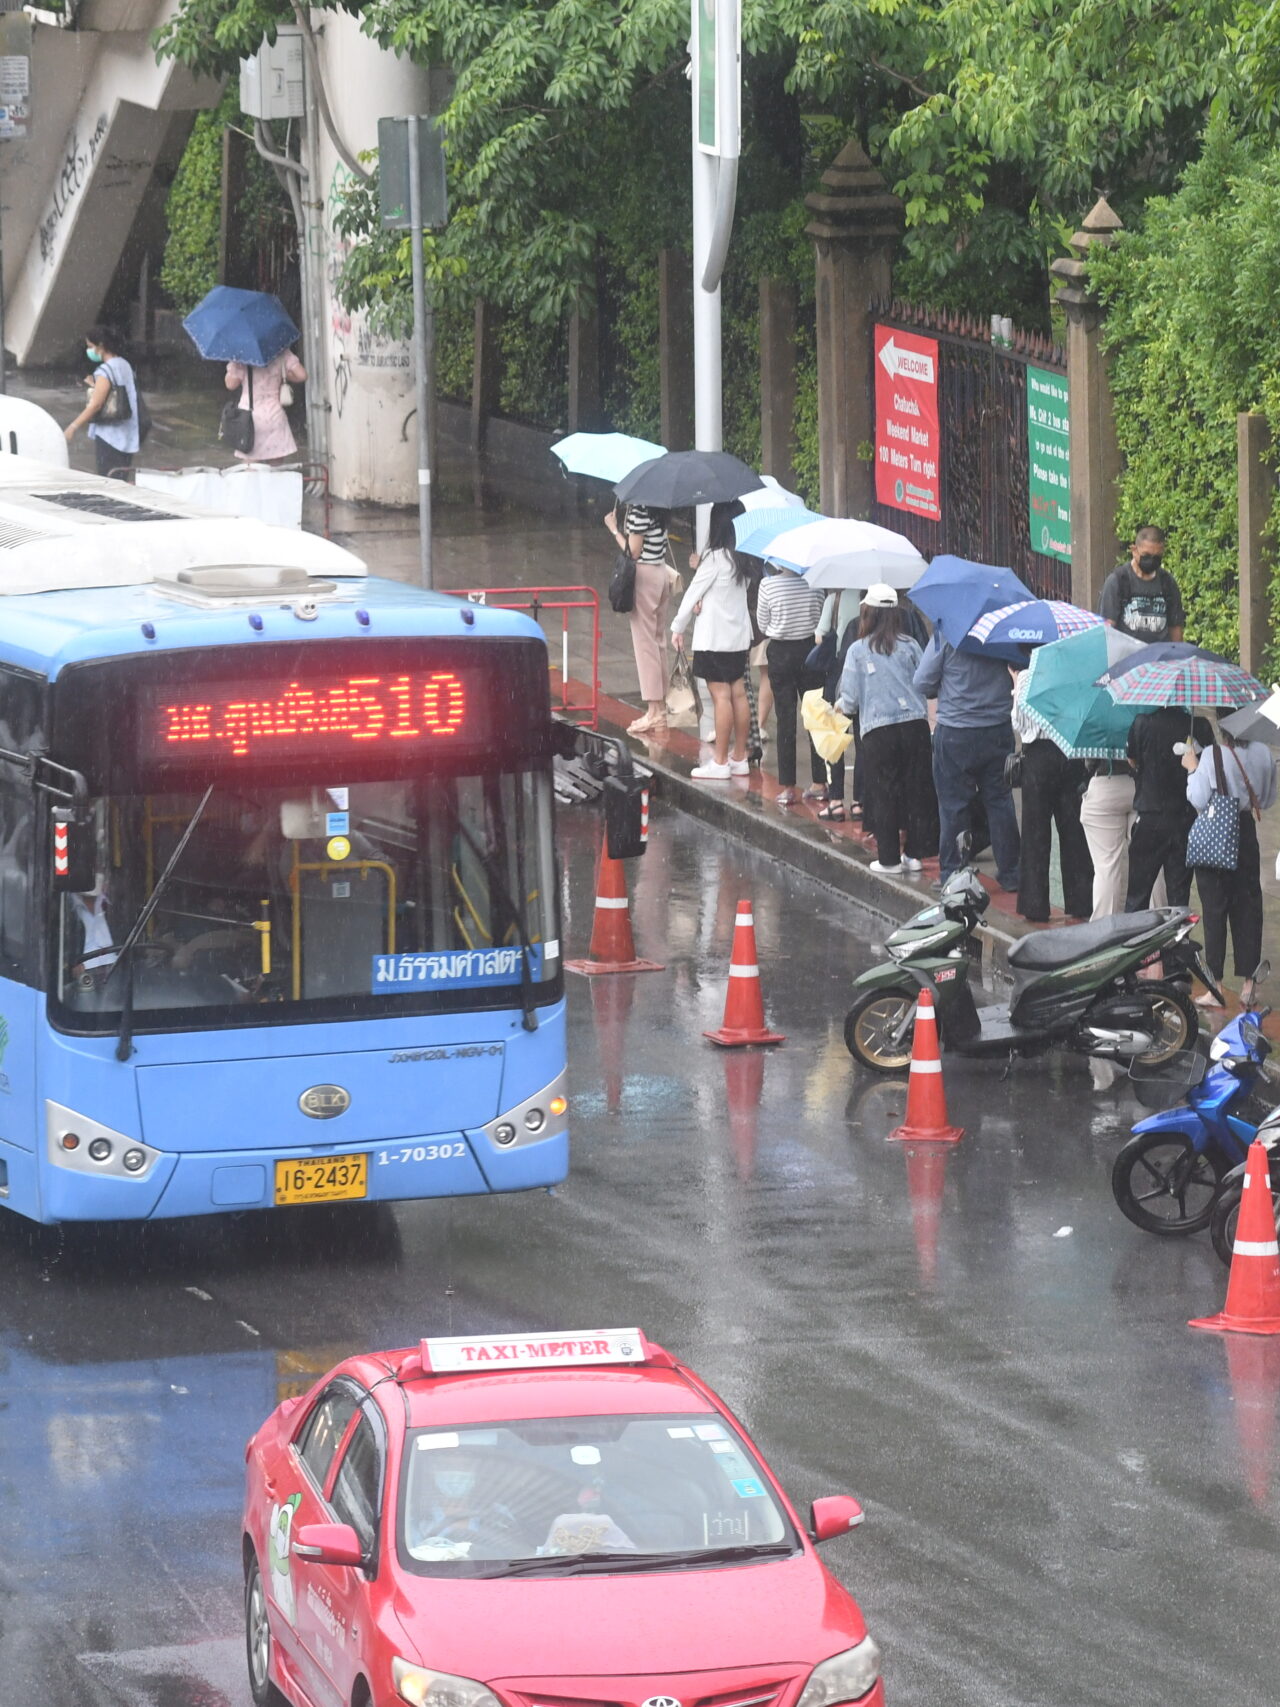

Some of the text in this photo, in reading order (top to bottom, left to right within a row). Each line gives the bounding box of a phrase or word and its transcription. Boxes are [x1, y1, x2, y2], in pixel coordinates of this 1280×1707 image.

[897, 355, 929, 377] WELCOME
[893, 393, 921, 417] Chatuchak
[1048, 411, 1052, 426] 2
[1052, 412, 1061, 429] bus
[886, 418, 929, 448] Weekend Market
[879, 445, 889, 463] 100
[890, 447, 909, 470] Meters
[910, 453, 922, 474] Turn
[1033, 462, 1068, 489] Please take the
[1057, 505, 1068, 522] from
[933, 967, 957, 984] YSS
[306, 1093, 343, 1108] BLK
[297, 1156, 347, 1167] THAILAND
[378, 1142, 466, 1166] 1-70302
[283, 1163, 362, 1193] 16-2437
[461, 1340, 612, 1362] TAXI-METER
